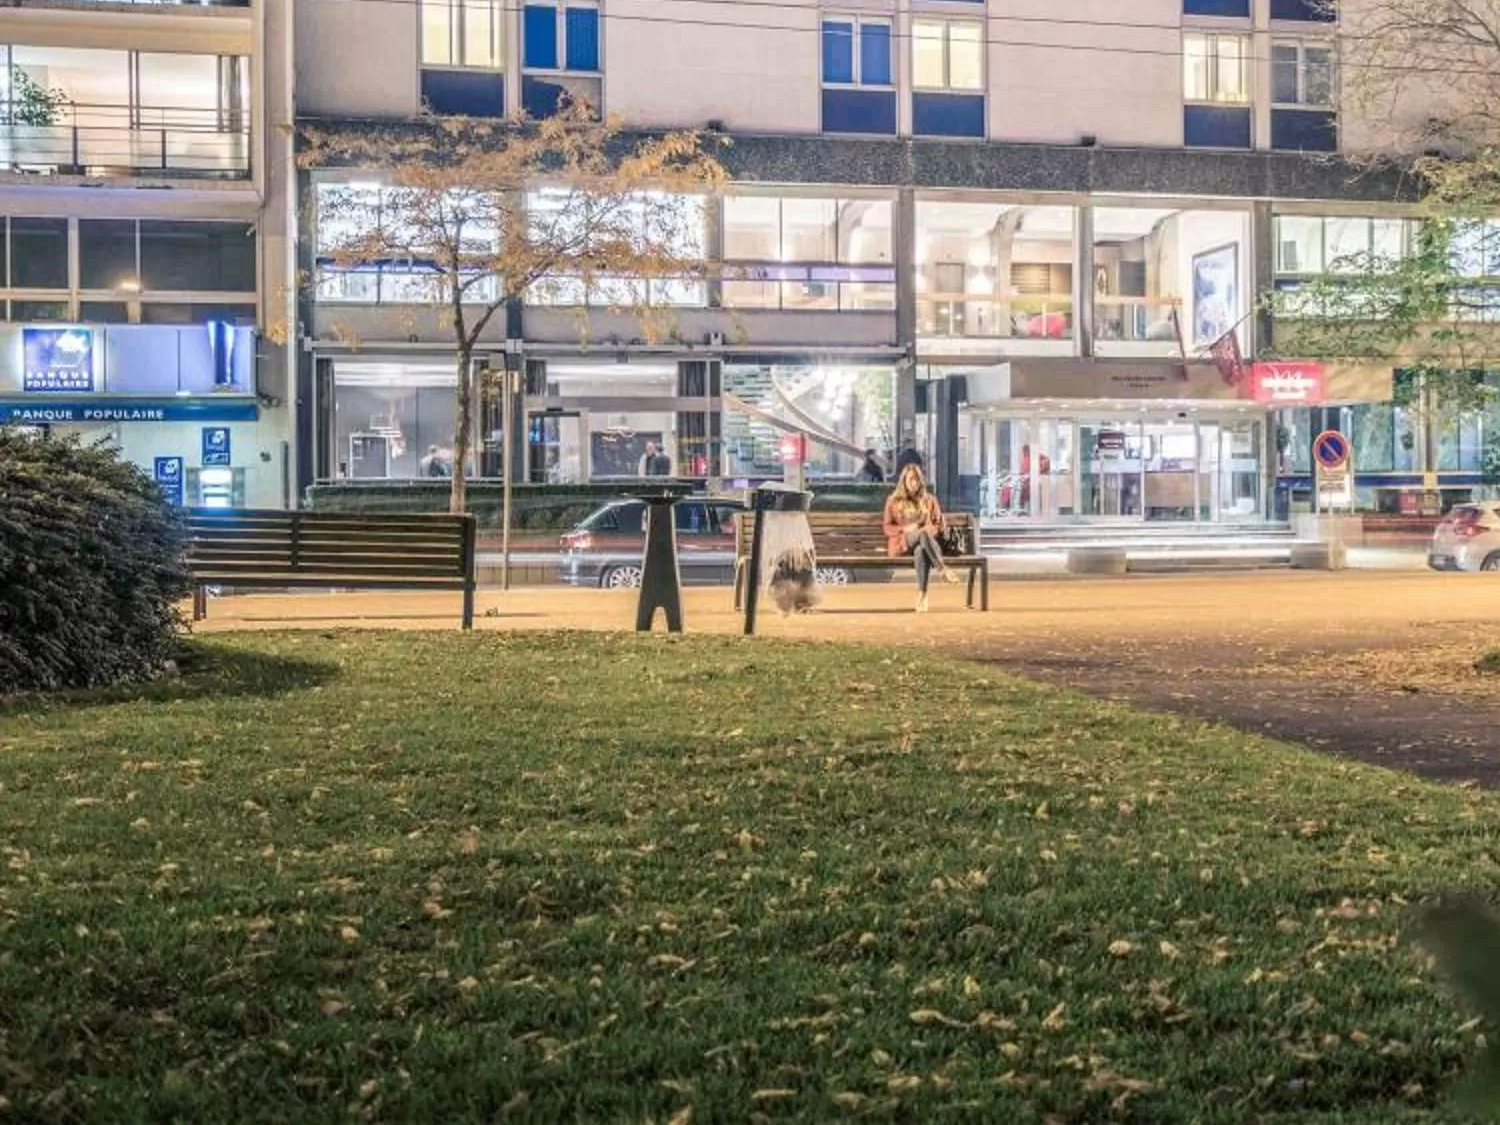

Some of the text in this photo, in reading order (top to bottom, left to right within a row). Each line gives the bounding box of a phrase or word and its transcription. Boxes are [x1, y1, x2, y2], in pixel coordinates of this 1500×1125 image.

[26, 371, 89, 380] BANQUE
[26, 380, 89, 388] POPULAIRE
[83, 409, 165, 420] POPULAIRE
